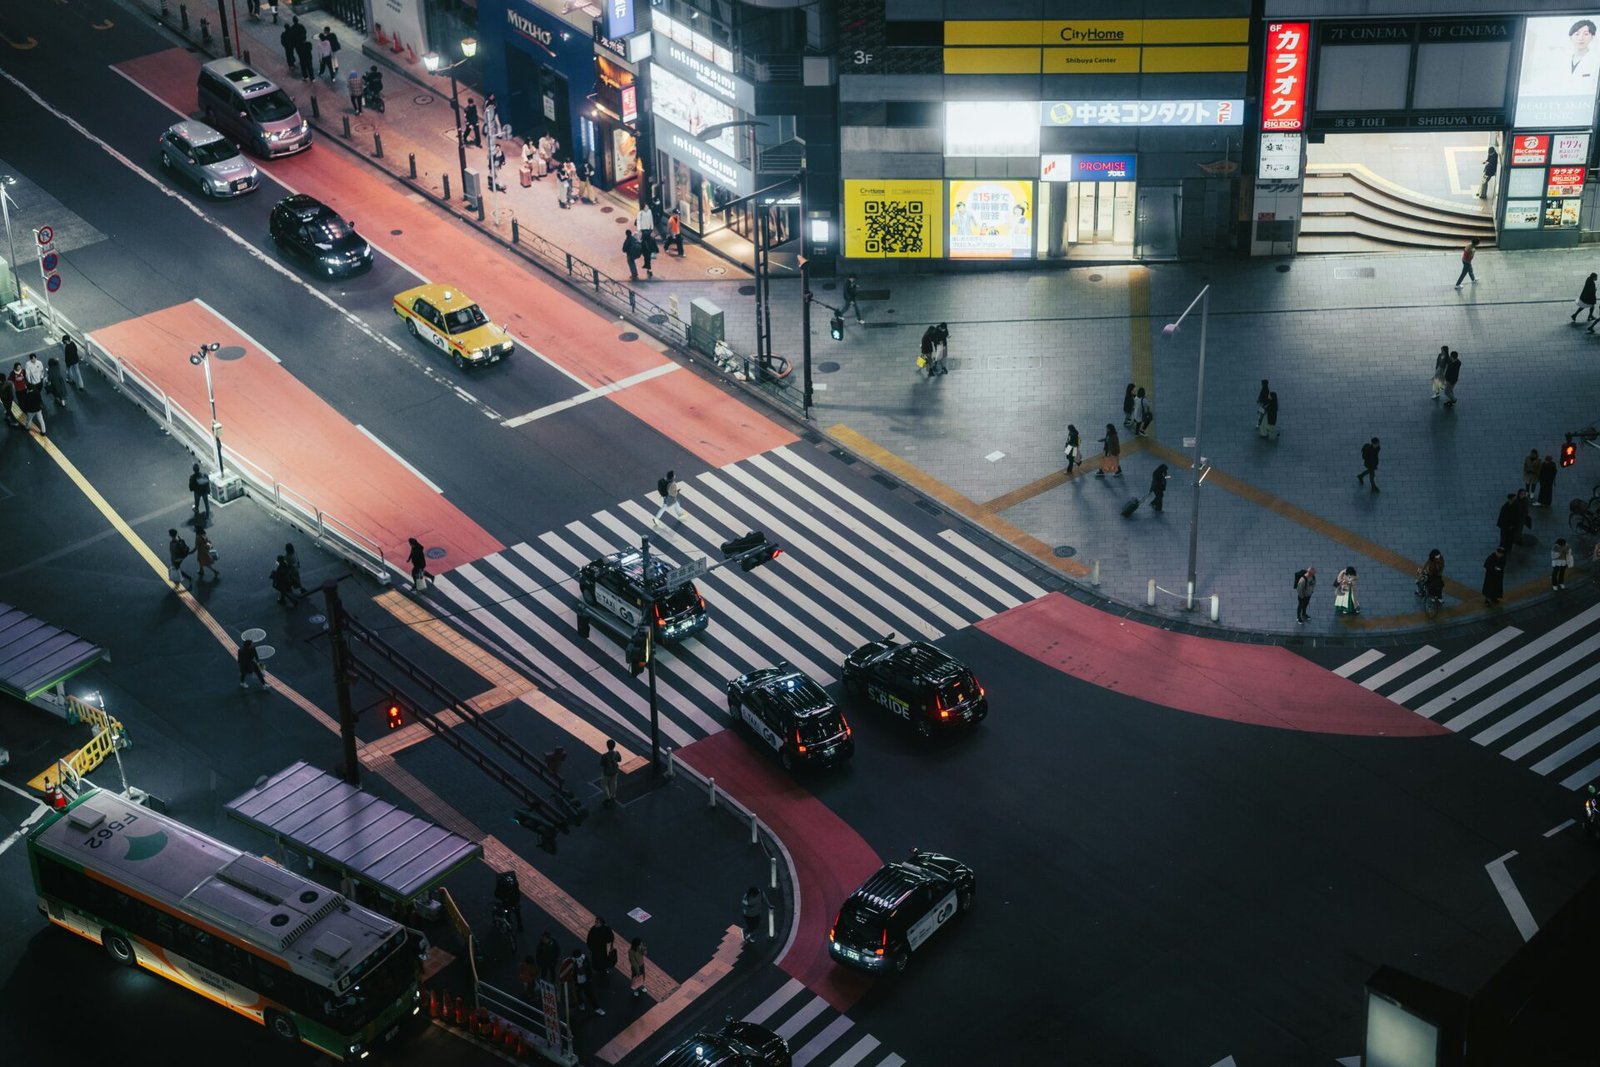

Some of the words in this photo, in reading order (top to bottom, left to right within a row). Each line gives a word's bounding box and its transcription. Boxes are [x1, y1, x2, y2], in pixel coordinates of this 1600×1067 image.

[507, 9, 552, 45] MIZUHO
[1060, 27, 1124, 42] CityHome
[1270, 24, 1282, 32] 6F
[1330, 29, 1349, 40] 7F
[1351, 27, 1408, 39] CINEMA
[1428, 27, 1446, 38] 9F
[1449, 25, 1508, 37] CINEMA
[853, 50, 873, 65] 3F
[671, 47, 735, 91] intimissimi
[1270, 30, 1300, 117] カラオケ
[1076, 103, 1210, 124] 中央コンタクト
[1417, 115, 1468, 127] SHIBUYA
[1471, 115, 1497, 125] TOEI
[1264, 121, 1278, 129] BIG
[1279, 121, 1301, 129] ECHO
[1335, 118, 1356, 128] 渋谷
[1361, 117, 1386, 127] TOEI
[673, 135, 737, 180] intimissimi
[1079, 161, 1126, 171] PROMISE
[84, 812, 138, 849] F562
